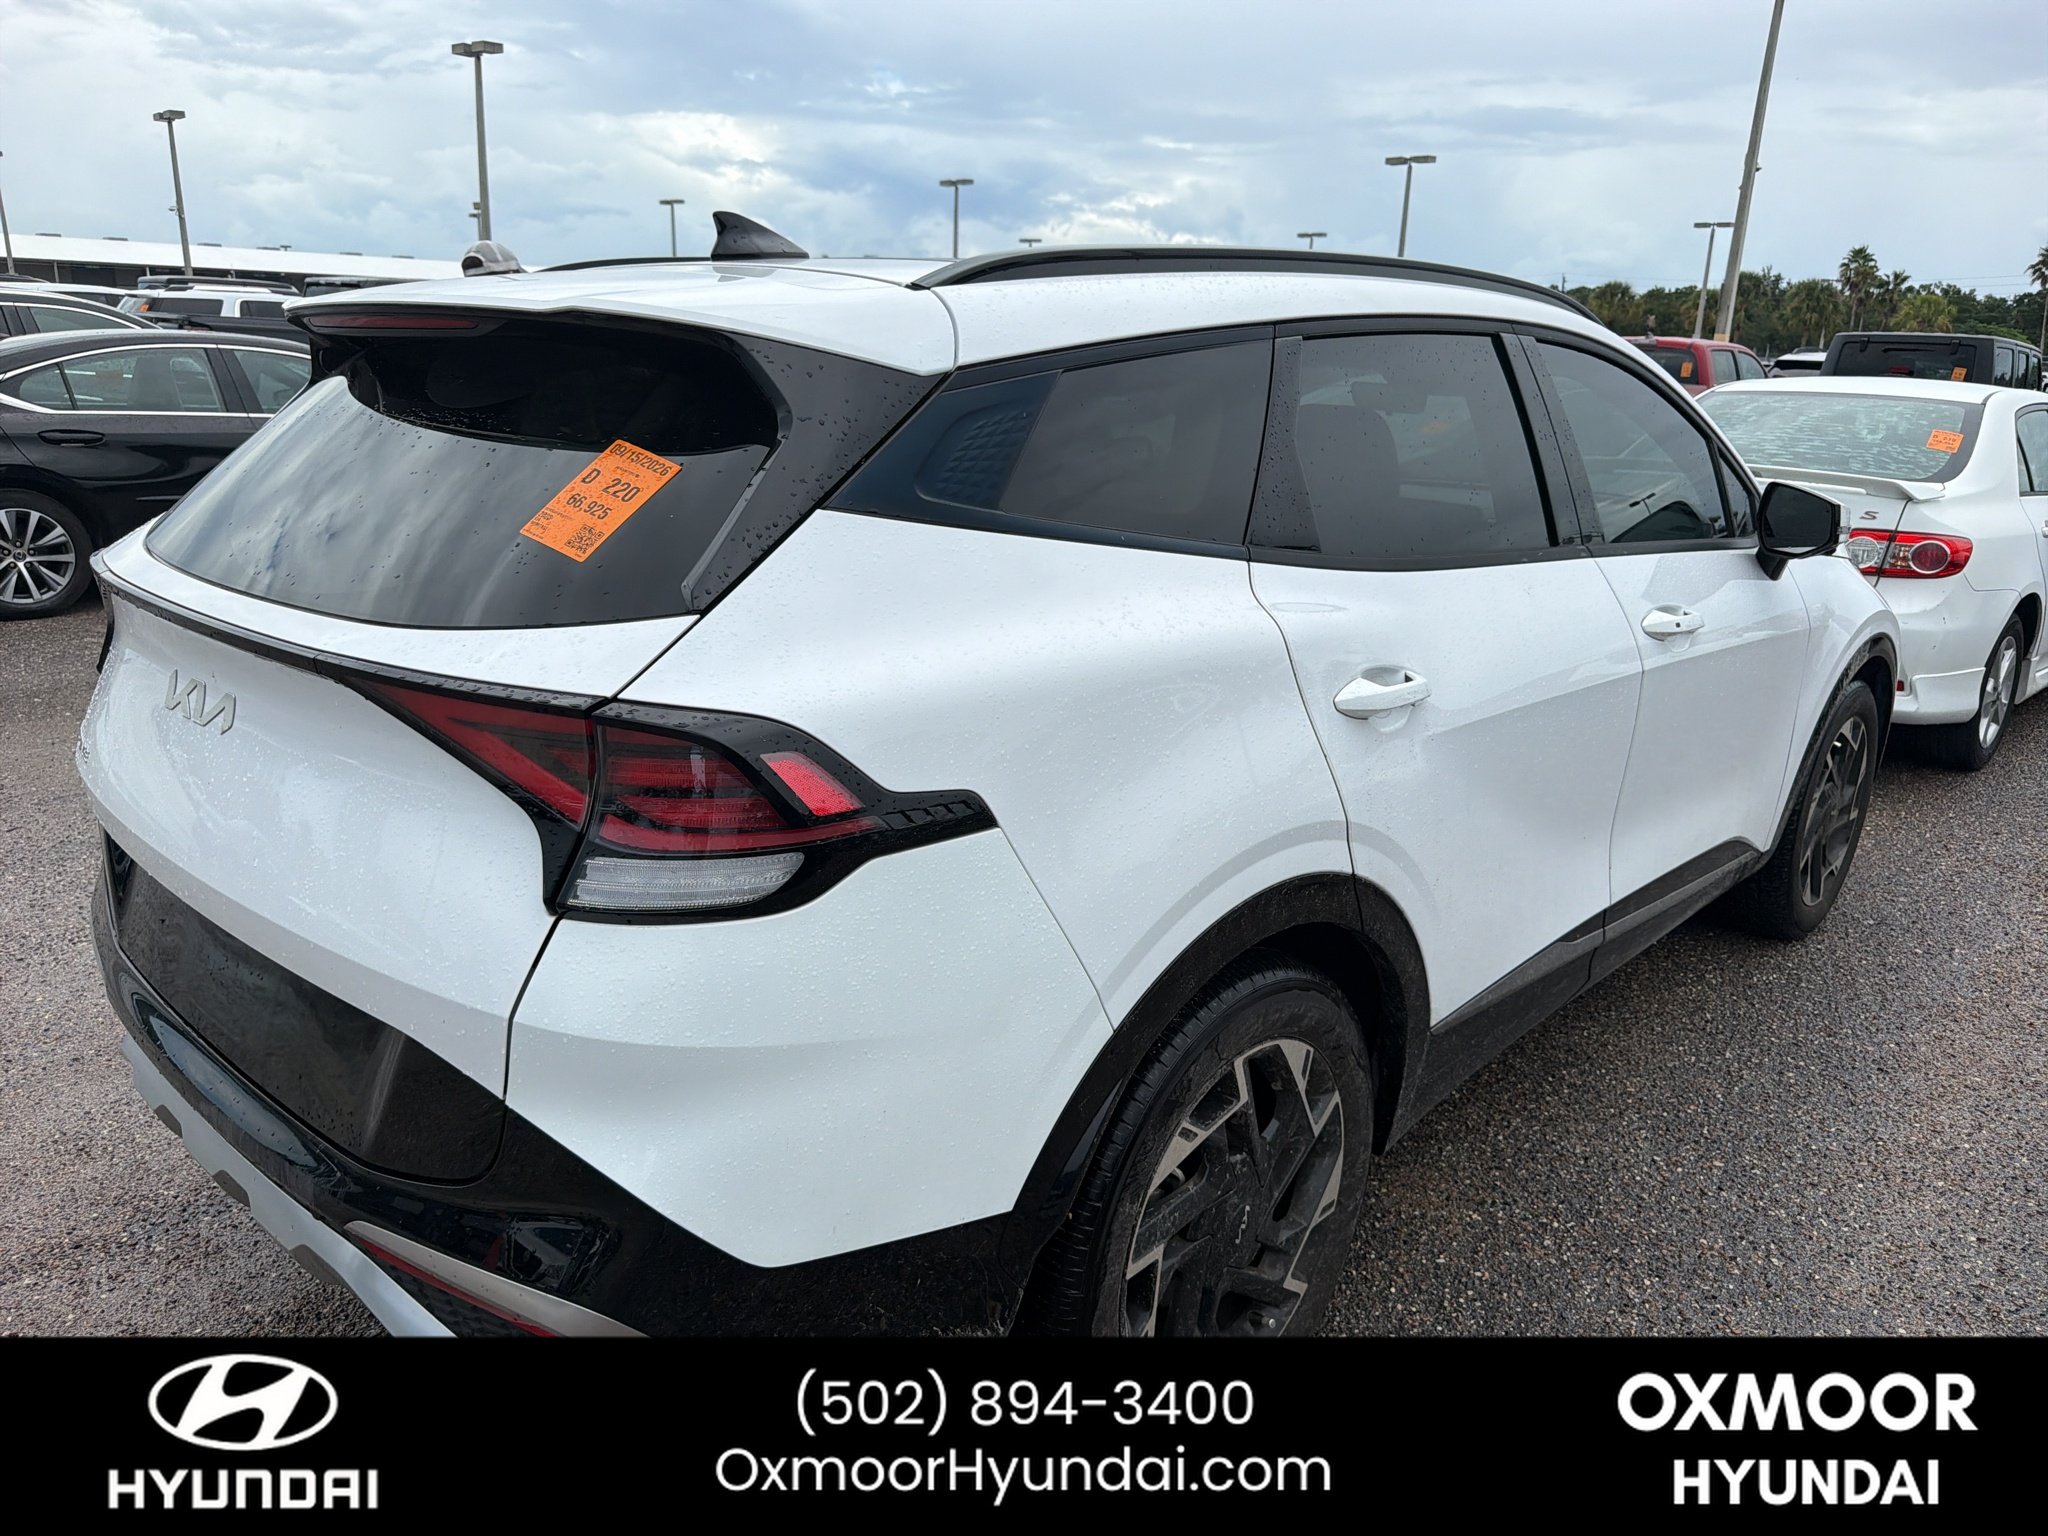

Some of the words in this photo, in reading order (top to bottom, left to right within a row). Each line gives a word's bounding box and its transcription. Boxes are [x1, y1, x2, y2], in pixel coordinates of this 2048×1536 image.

[609, 443, 673, 477] 09/15/2026
[581, 468, 601, 484] D
[601, 478, 641, 503] 220
[566, 493, 612, 520] 66,925
[1859, 510, 1879, 520] S
